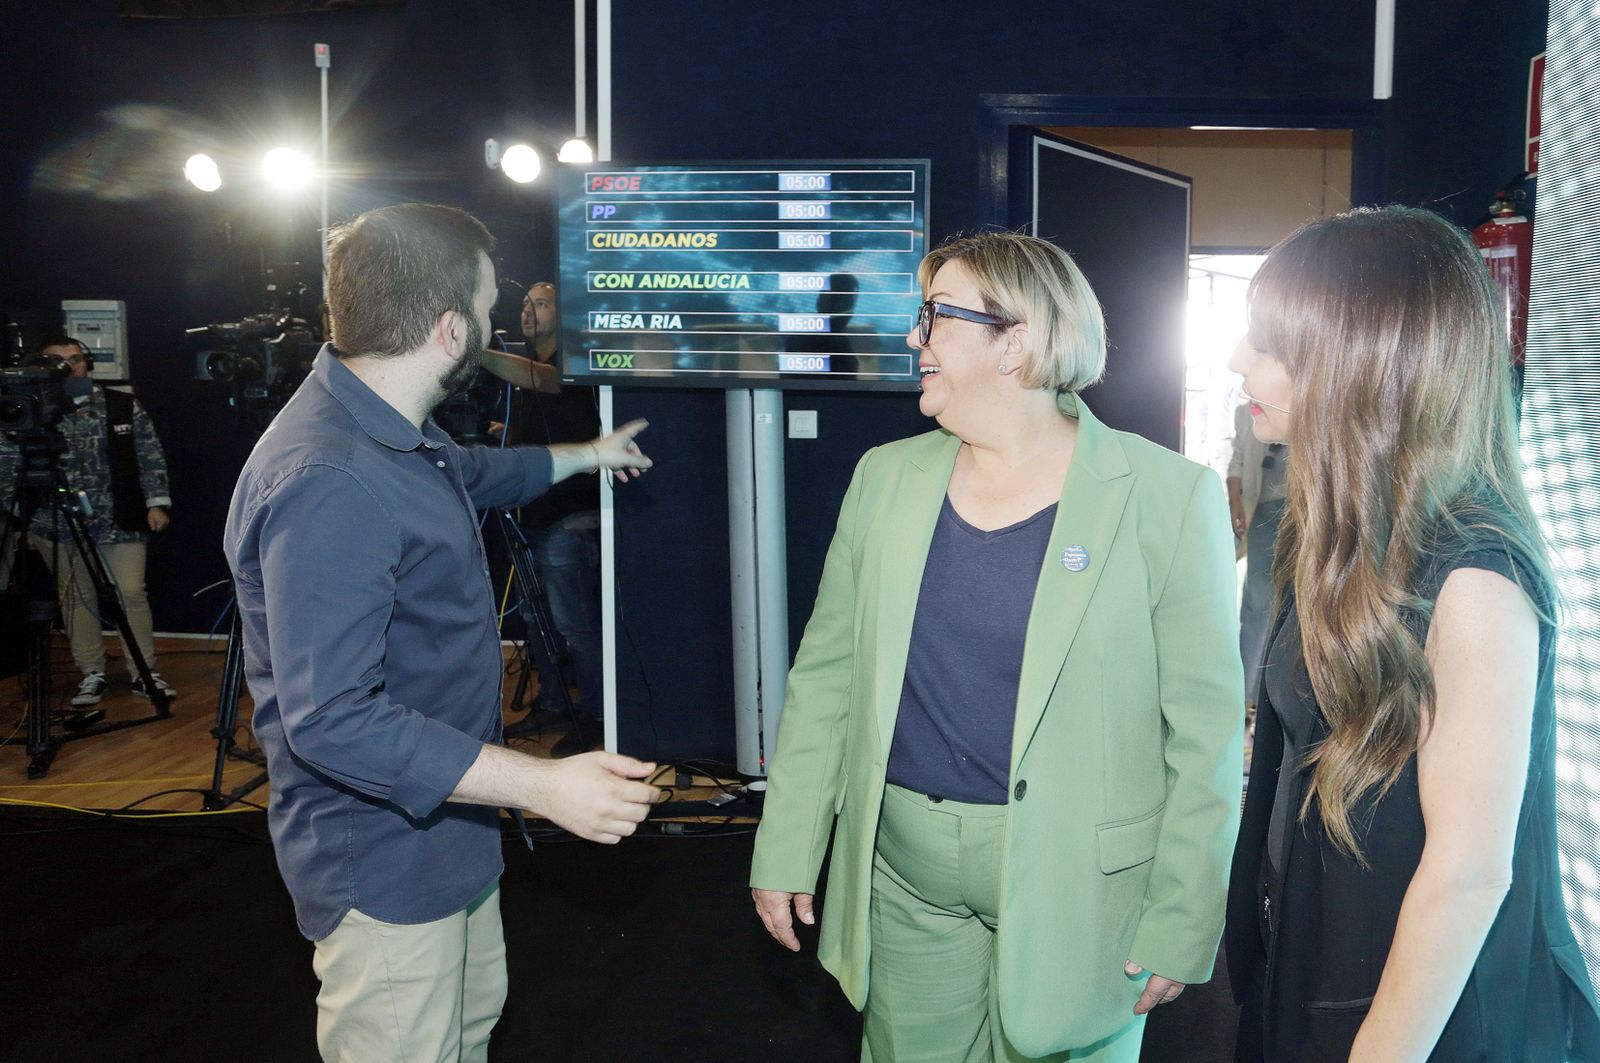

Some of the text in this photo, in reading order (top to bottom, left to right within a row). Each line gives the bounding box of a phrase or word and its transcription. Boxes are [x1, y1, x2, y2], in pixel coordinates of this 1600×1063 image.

[591, 176, 641, 191] PSOE
[786, 176, 825, 189] 05:00
[592, 205, 616, 219] PP
[786, 205, 825, 218] 05:00
[592, 233, 718, 248] CIUDADANOS
[786, 234, 825, 248] 05:00
[593, 274, 750, 289] CON ANDALUCIA
[786, 276, 825, 289] 05:00
[594, 315, 683, 329] MESA RIA
[786, 317, 825, 330] 05:00
[596, 354, 634, 368] VOX
[786, 357, 825, 370] 05:00
